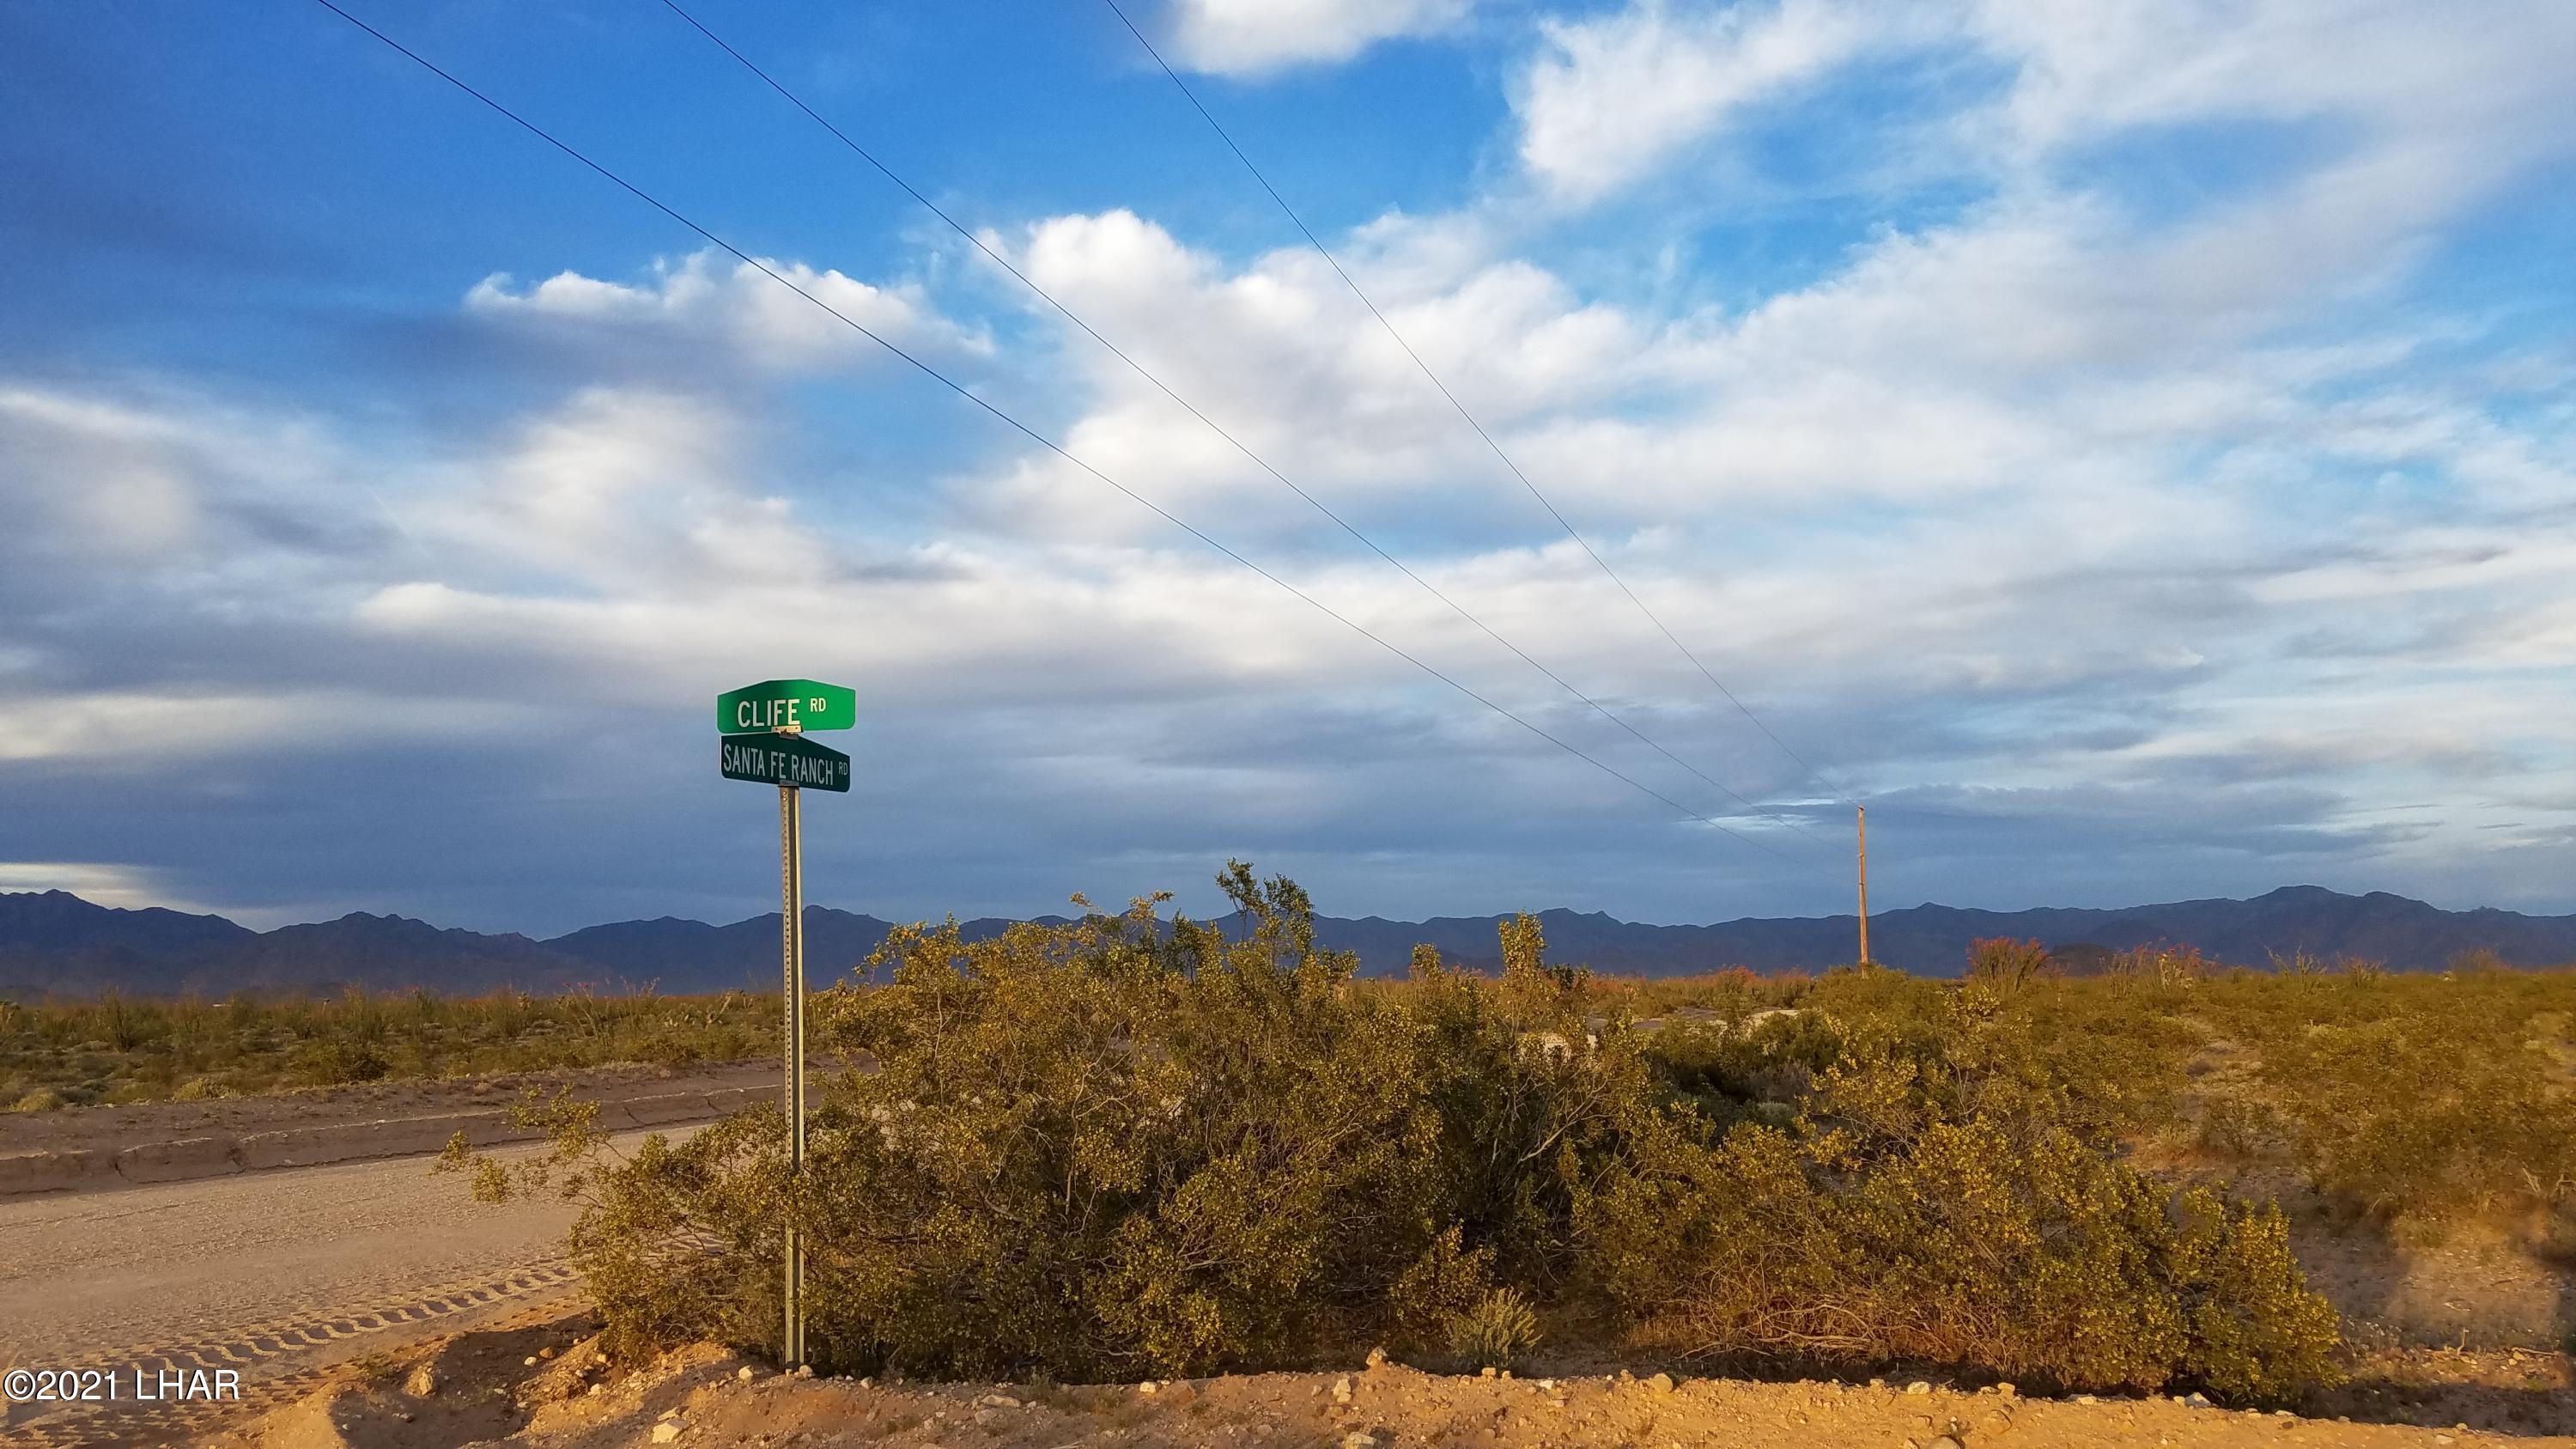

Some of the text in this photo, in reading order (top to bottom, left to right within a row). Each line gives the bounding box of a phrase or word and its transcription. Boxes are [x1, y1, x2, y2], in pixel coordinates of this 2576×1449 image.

[738, 697, 827, 728] CLIFE RD
[723, 743, 848, 786] SANTA FE RANCH RD
